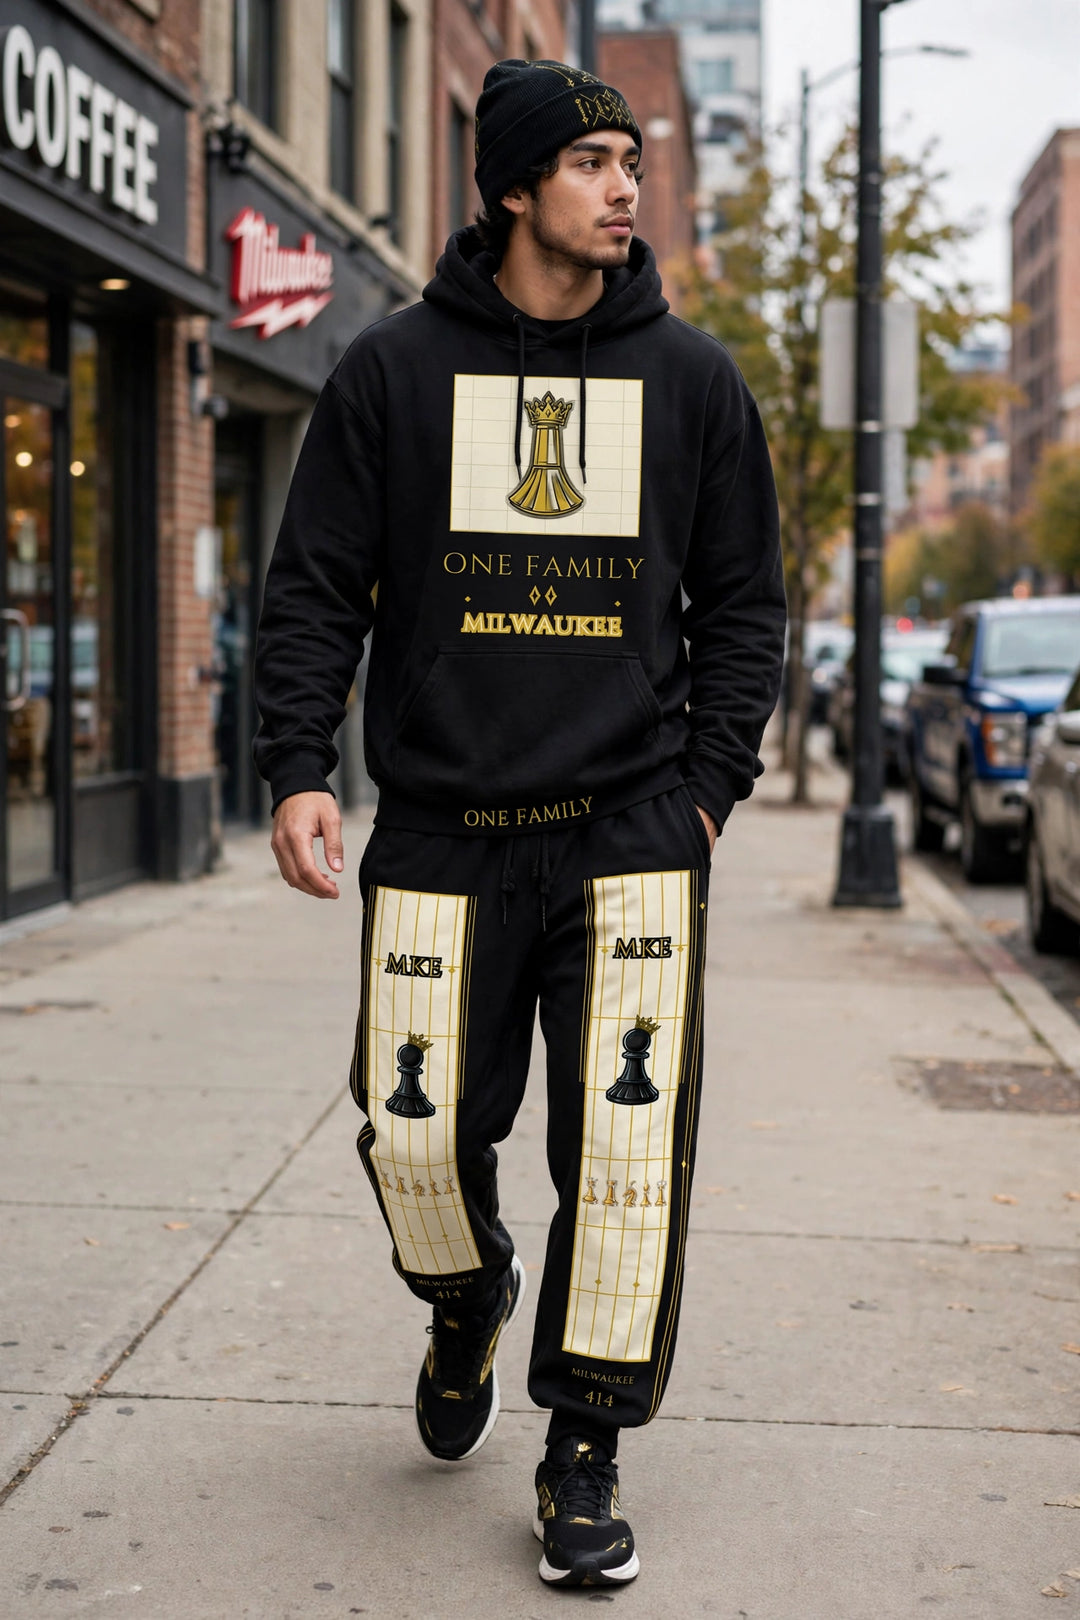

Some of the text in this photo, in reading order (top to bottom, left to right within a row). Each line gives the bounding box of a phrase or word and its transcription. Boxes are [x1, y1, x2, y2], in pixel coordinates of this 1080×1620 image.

[3, 25, 159, 225] COFFEE
[443, 552, 645, 579] ONE FAMILY
[460, 611, 623, 638] MILWAUKEE
[464, 796, 592, 827] ONE FAMILY
[612, 936, 672, 959] MKE
[384, 951, 443, 979] MKE
[415, 1277, 473, 1287] MILWAUKEE
[435, 1290, 461, 1299] 414
[571, 1367, 636, 1385] MILWAUKEE
[584, 1390, 614, 1407] 414
